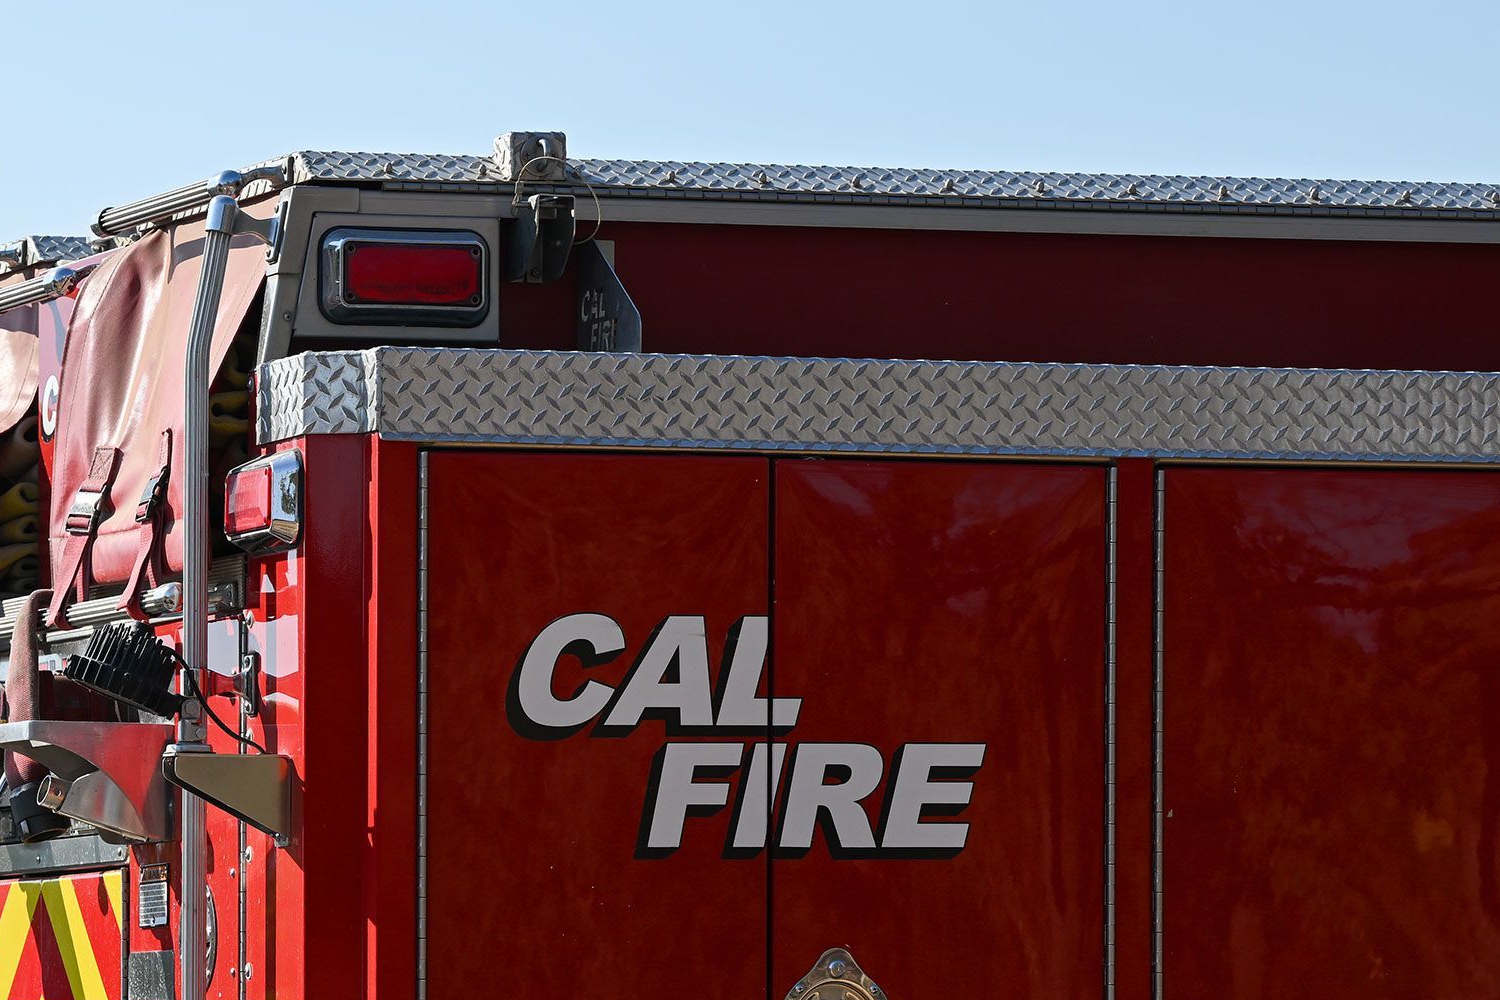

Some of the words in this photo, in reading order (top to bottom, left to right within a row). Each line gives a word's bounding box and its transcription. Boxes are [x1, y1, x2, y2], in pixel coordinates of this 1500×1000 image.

[581, 289, 605, 322] CAL
[505, 611, 804, 739] CAL
[633, 741, 987, 860] FIRE
